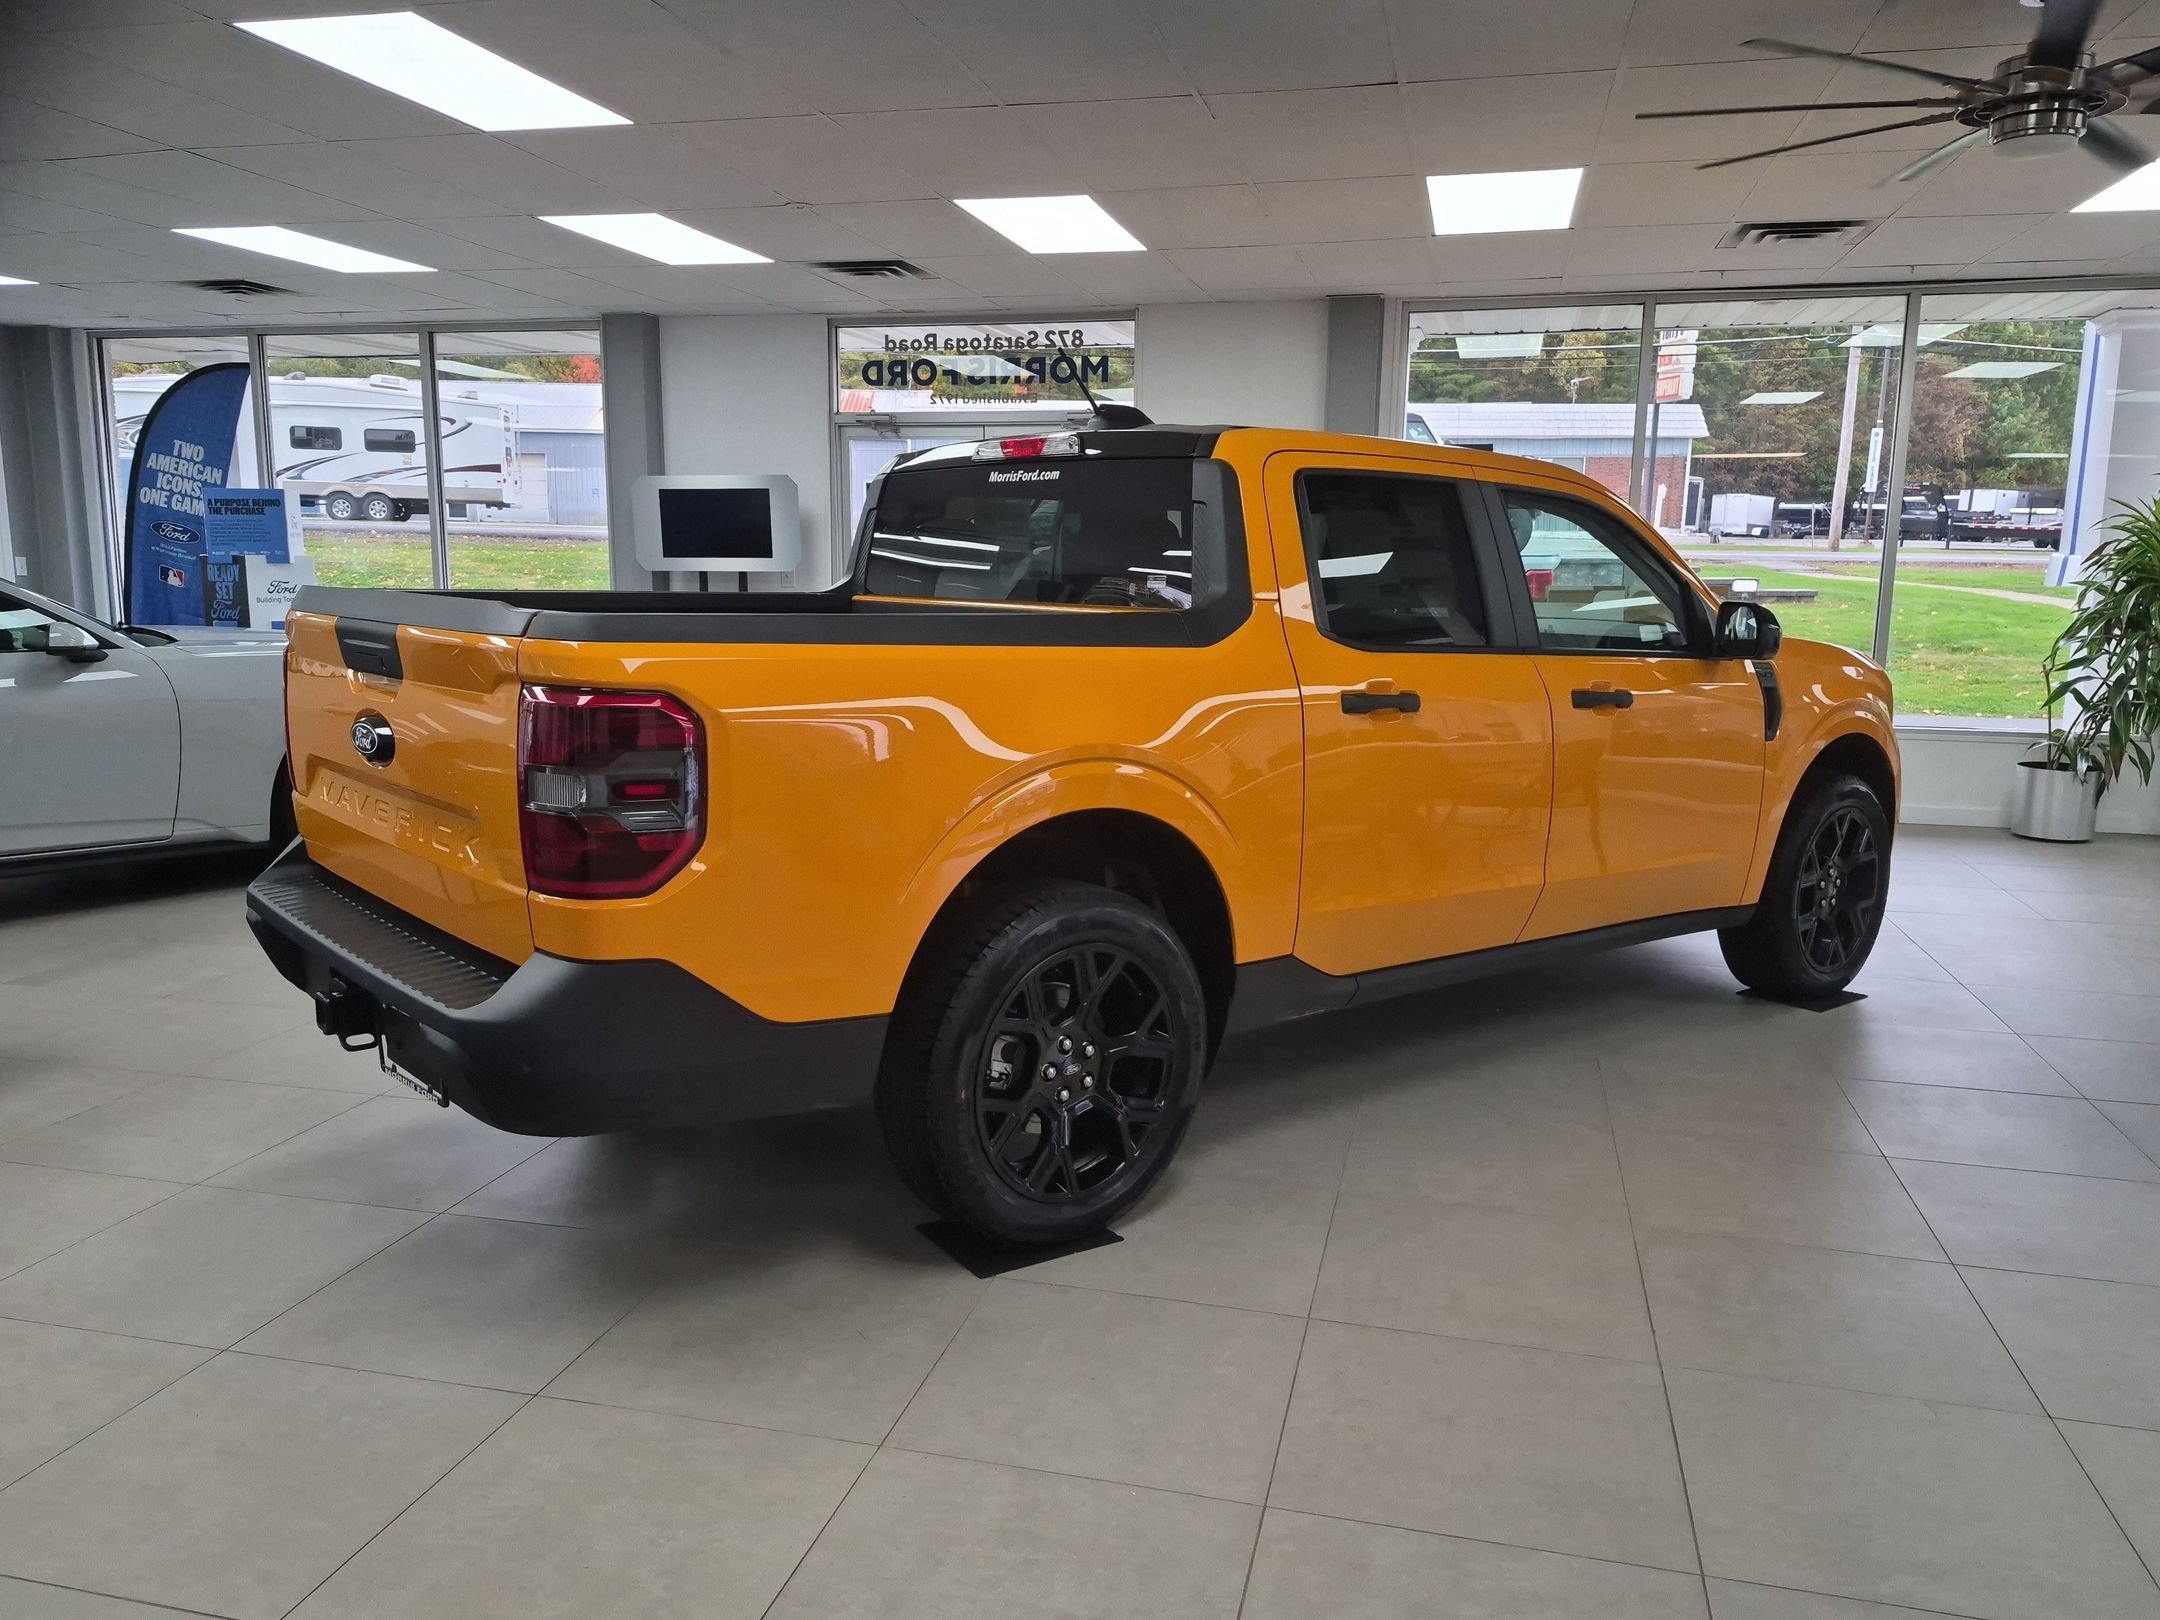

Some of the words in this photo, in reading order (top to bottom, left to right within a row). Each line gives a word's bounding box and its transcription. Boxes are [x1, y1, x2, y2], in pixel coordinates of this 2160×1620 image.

[173, 439, 204, 462] TWO
[146, 452, 223, 485] AMERICAN
[988, 469, 1060, 483] MorrisFord.com
[140, 486, 170, 508] ONE
[171, 494, 204, 516] GAM
[207, 498, 213, 506] A
[214, 498, 251, 507] PURPOSE
[252, 498, 281, 507] BEHIND
[208, 507, 224, 515] THE
[224, 507, 266, 516] PURCHASE
[160, 523, 191, 541] Ford
[208, 564, 240, 582] READY
[215, 581, 234, 600] SET
[267, 580, 298, 594] Ford
[210, 600, 240, 620] Ford
[354, 726, 372, 750] Ford
[319, 777, 480, 864] MAVERICK
